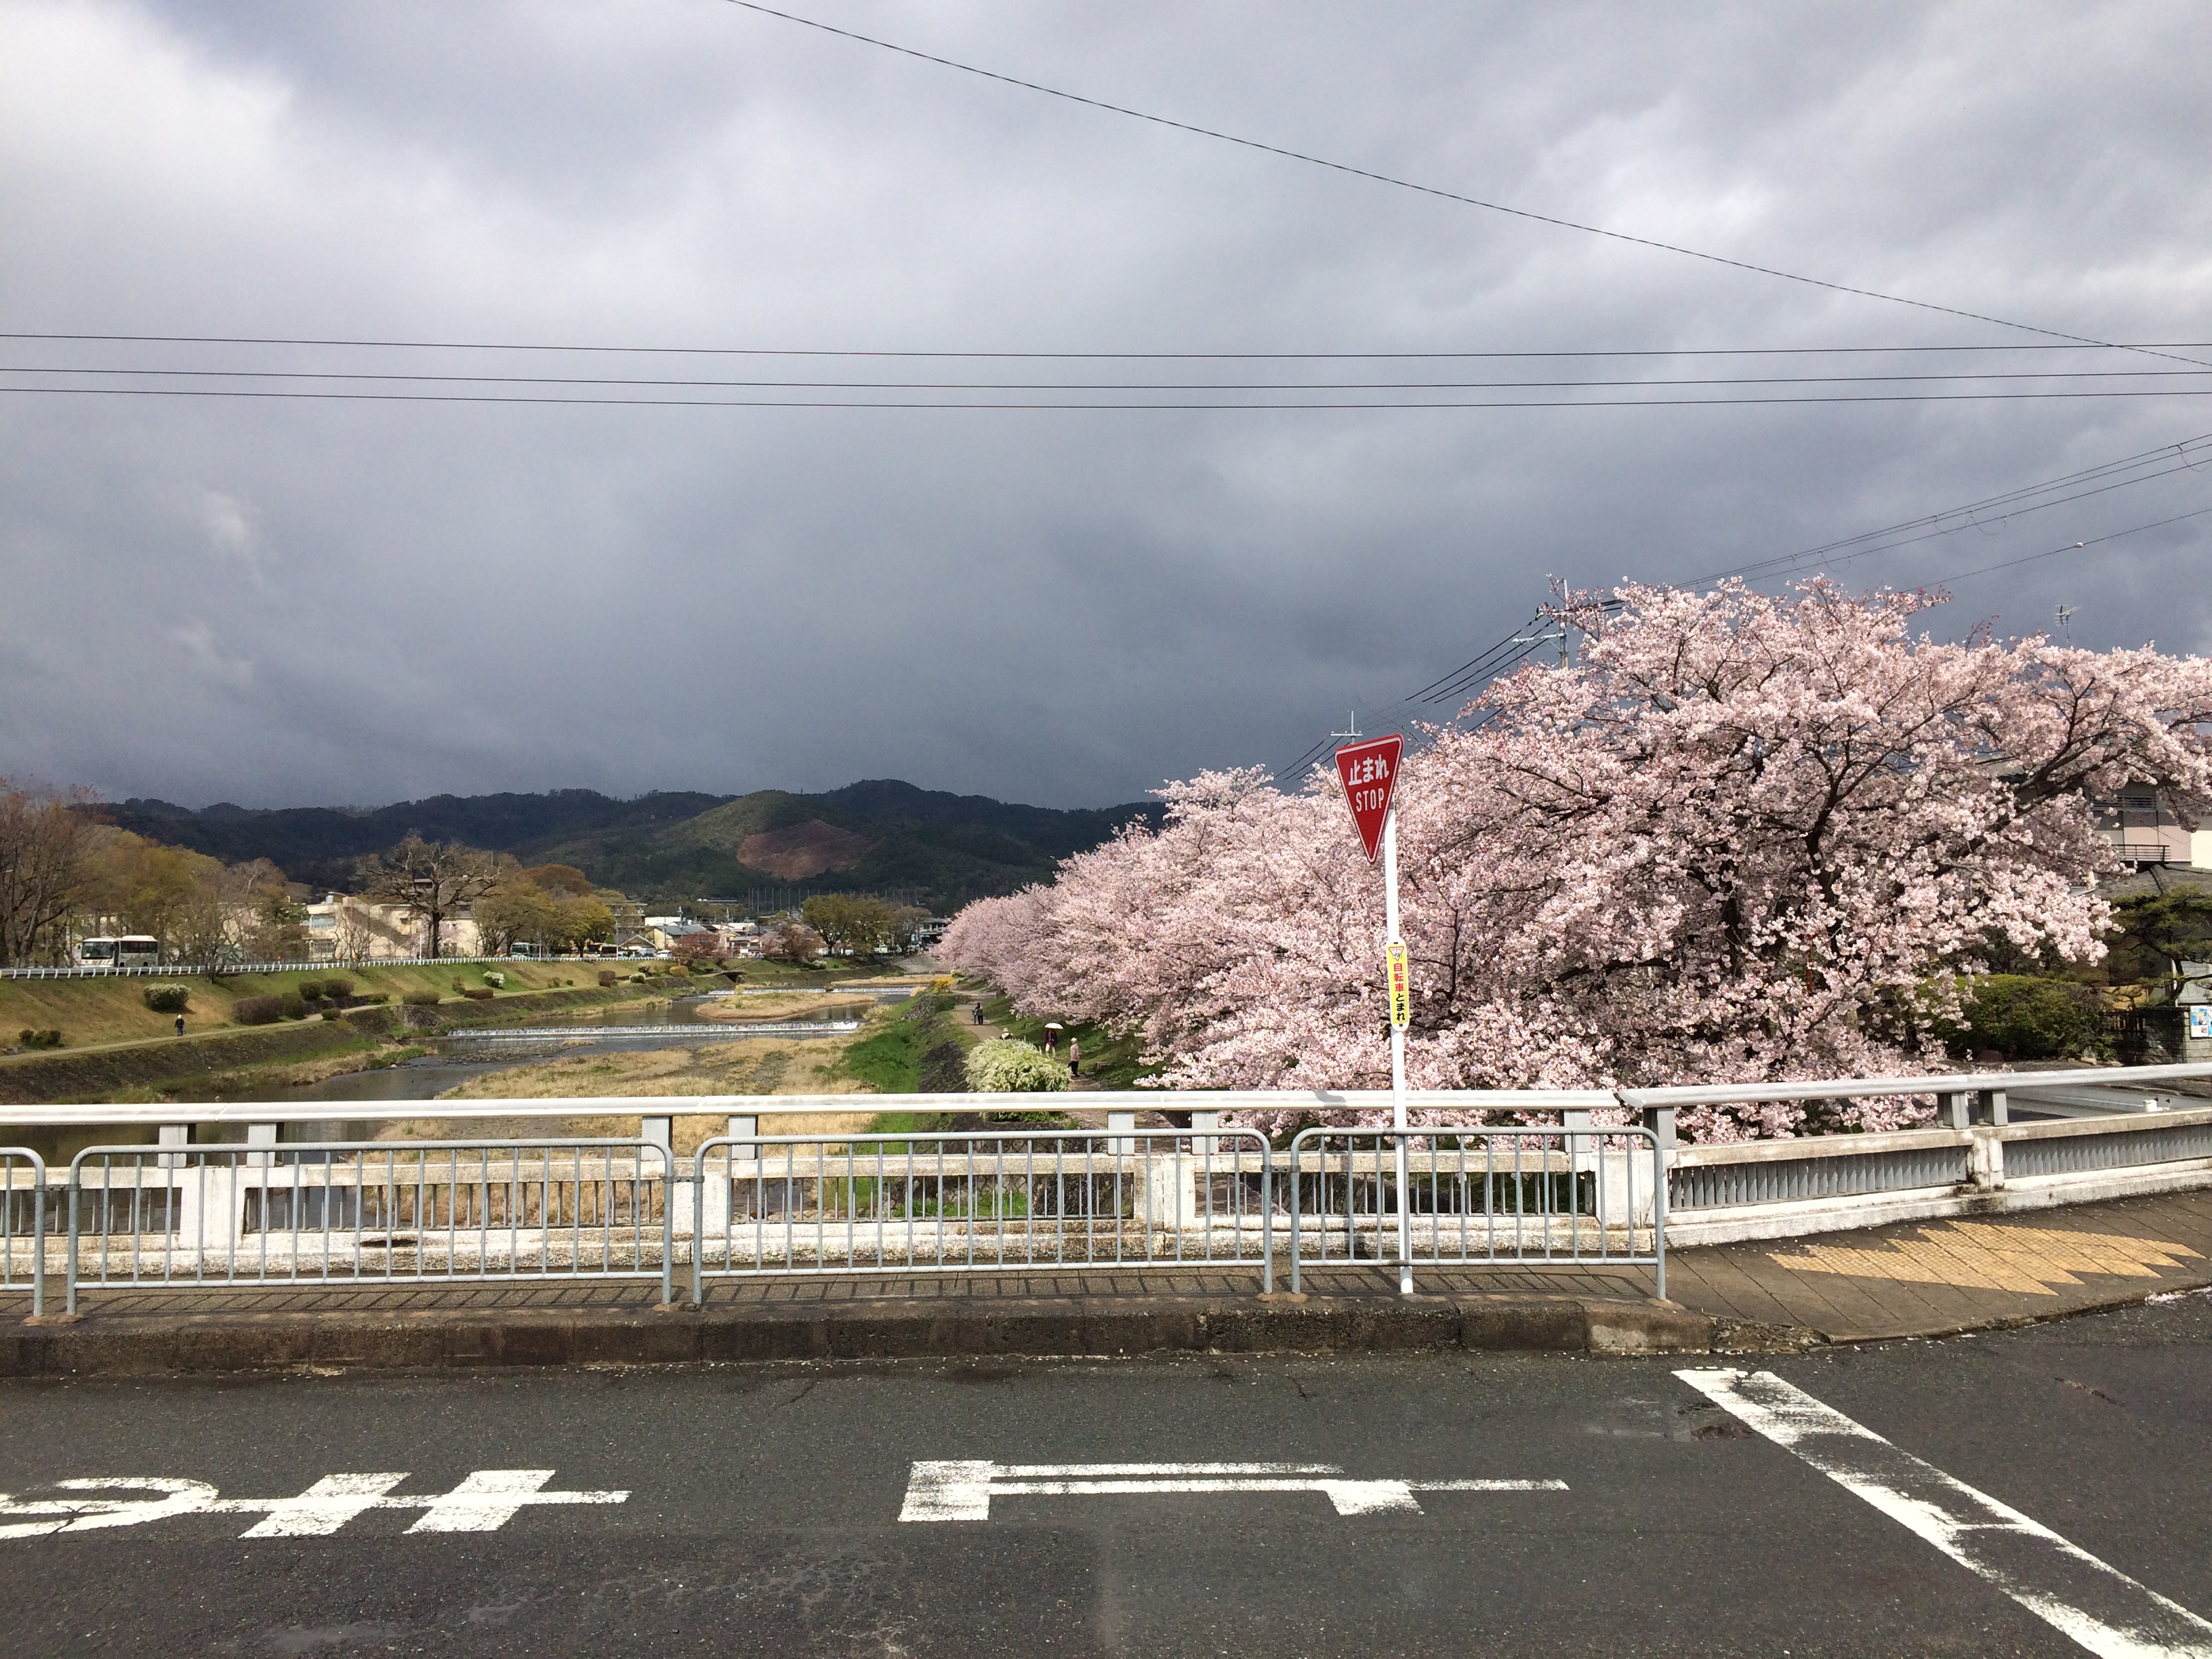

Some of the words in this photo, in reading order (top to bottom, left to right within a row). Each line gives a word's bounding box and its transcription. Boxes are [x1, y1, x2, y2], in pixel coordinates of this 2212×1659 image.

[1348, 754, 1389, 786] 止まれ
[1355, 788, 1385, 813] STOP
[1393, 963, 1405, 1021] 自転車とまれ
